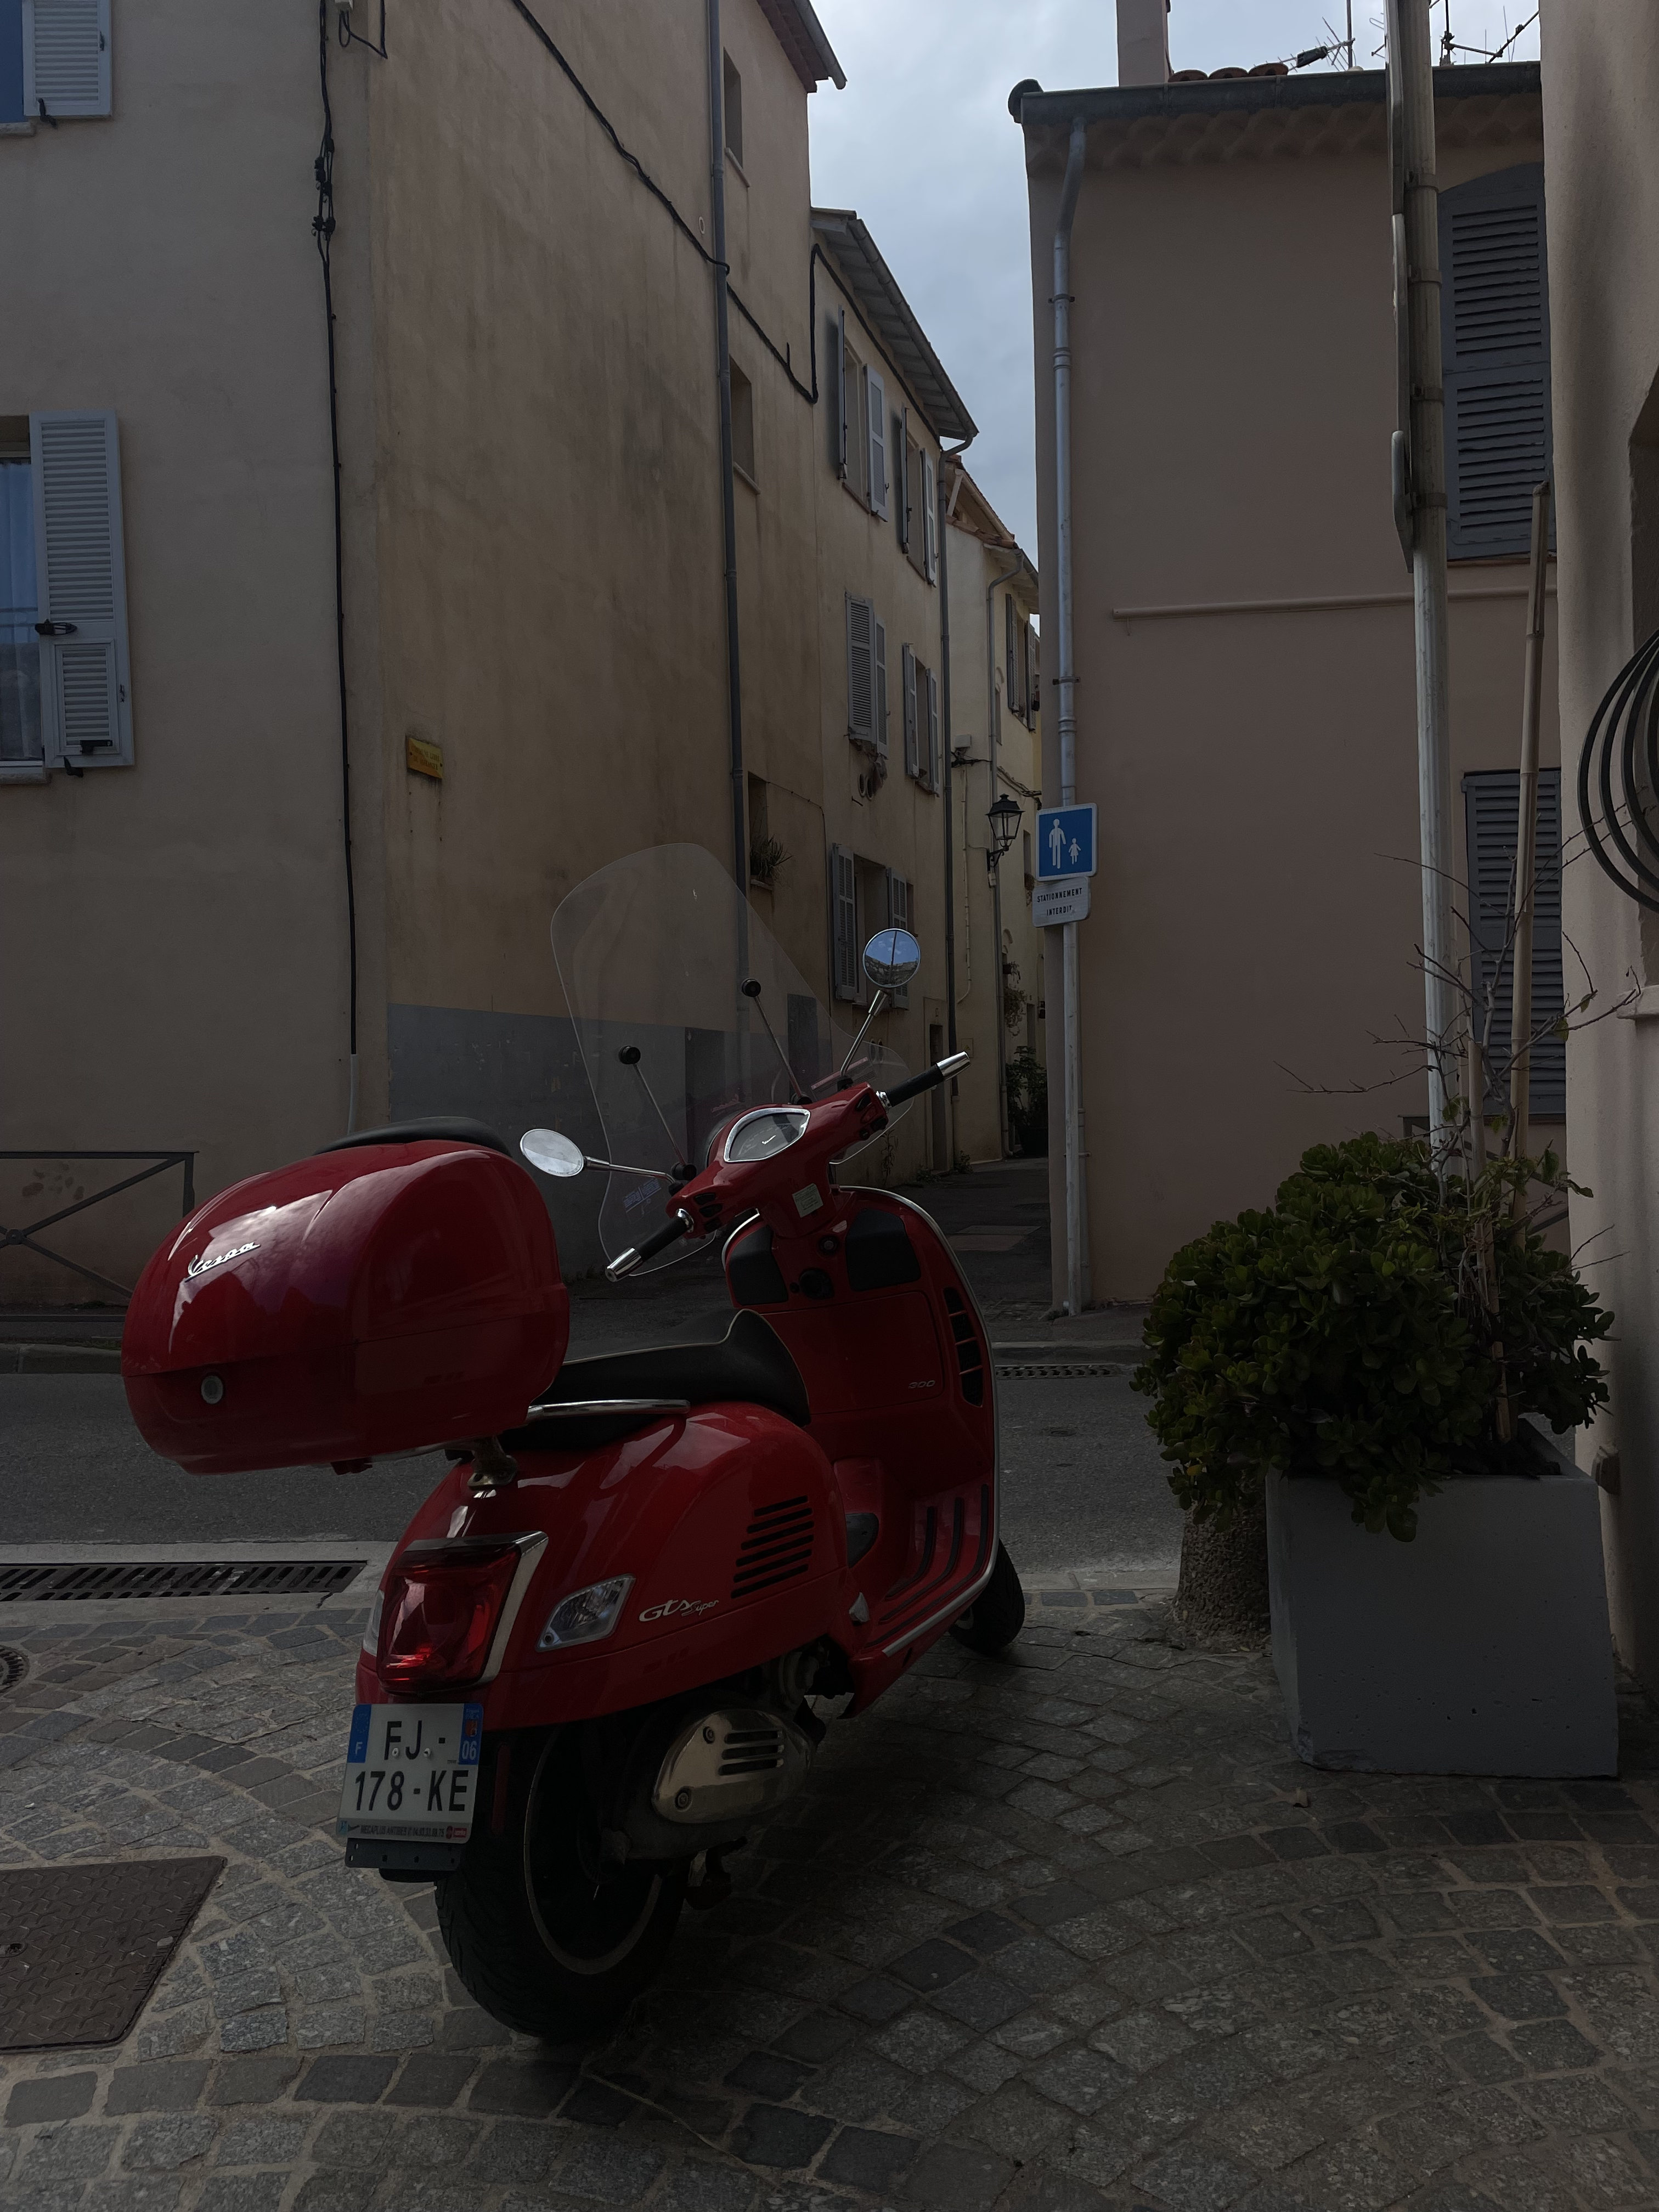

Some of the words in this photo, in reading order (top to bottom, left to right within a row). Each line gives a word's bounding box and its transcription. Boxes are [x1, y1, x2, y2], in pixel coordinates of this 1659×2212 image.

[1037, 888, 1082, 902] STATIONNEMENT
[1047, 905, 1071, 916] INTERDIT
[185, 1242, 261, 1281] Vespa
[909, 1380, 935, 1389] 300
[355, 1742, 363, 1756] F
[462, 1740, 477, 1760] 06
